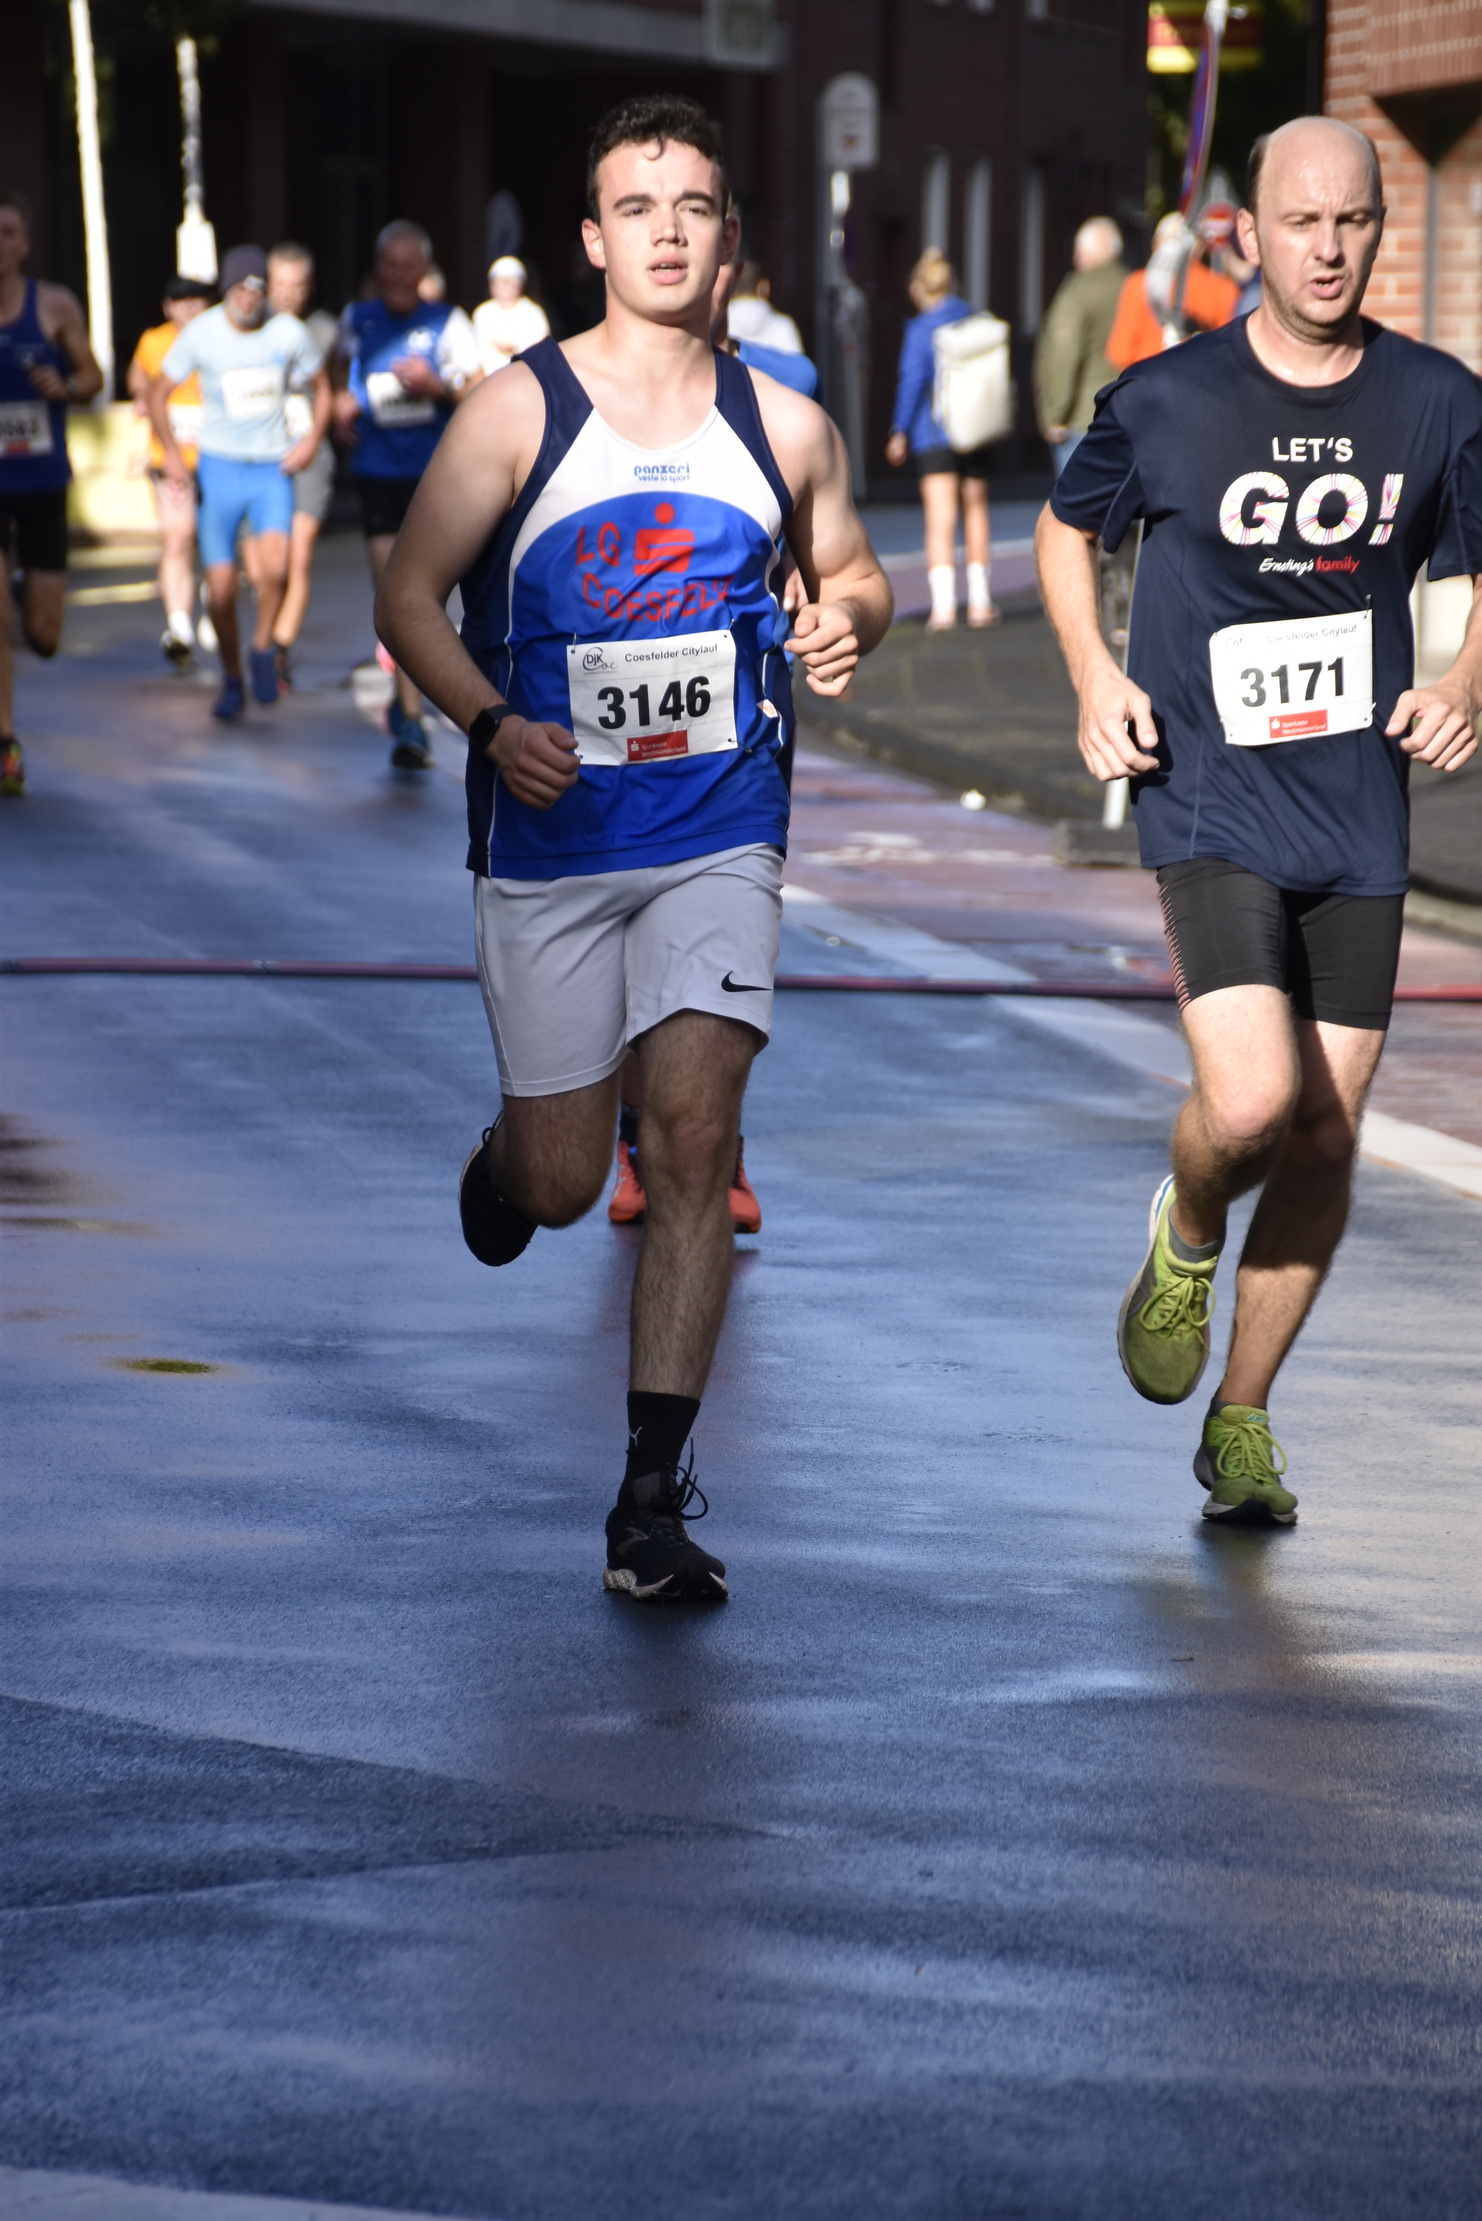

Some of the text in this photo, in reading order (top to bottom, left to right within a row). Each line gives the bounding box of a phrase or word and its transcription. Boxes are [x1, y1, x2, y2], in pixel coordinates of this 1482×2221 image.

[1272, 436, 1353, 463] LET'S
[1219, 471, 1404, 546] GO!
[576, 521, 622, 567] LG
[1315, 555, 1360, 575] family
[624, 650, 679, 663] Coesfelder
[681, 643, 718, 659] Citylauf
[597, 675, 711, 729] 3146
[1240, 656, 1345, 708] 3171
